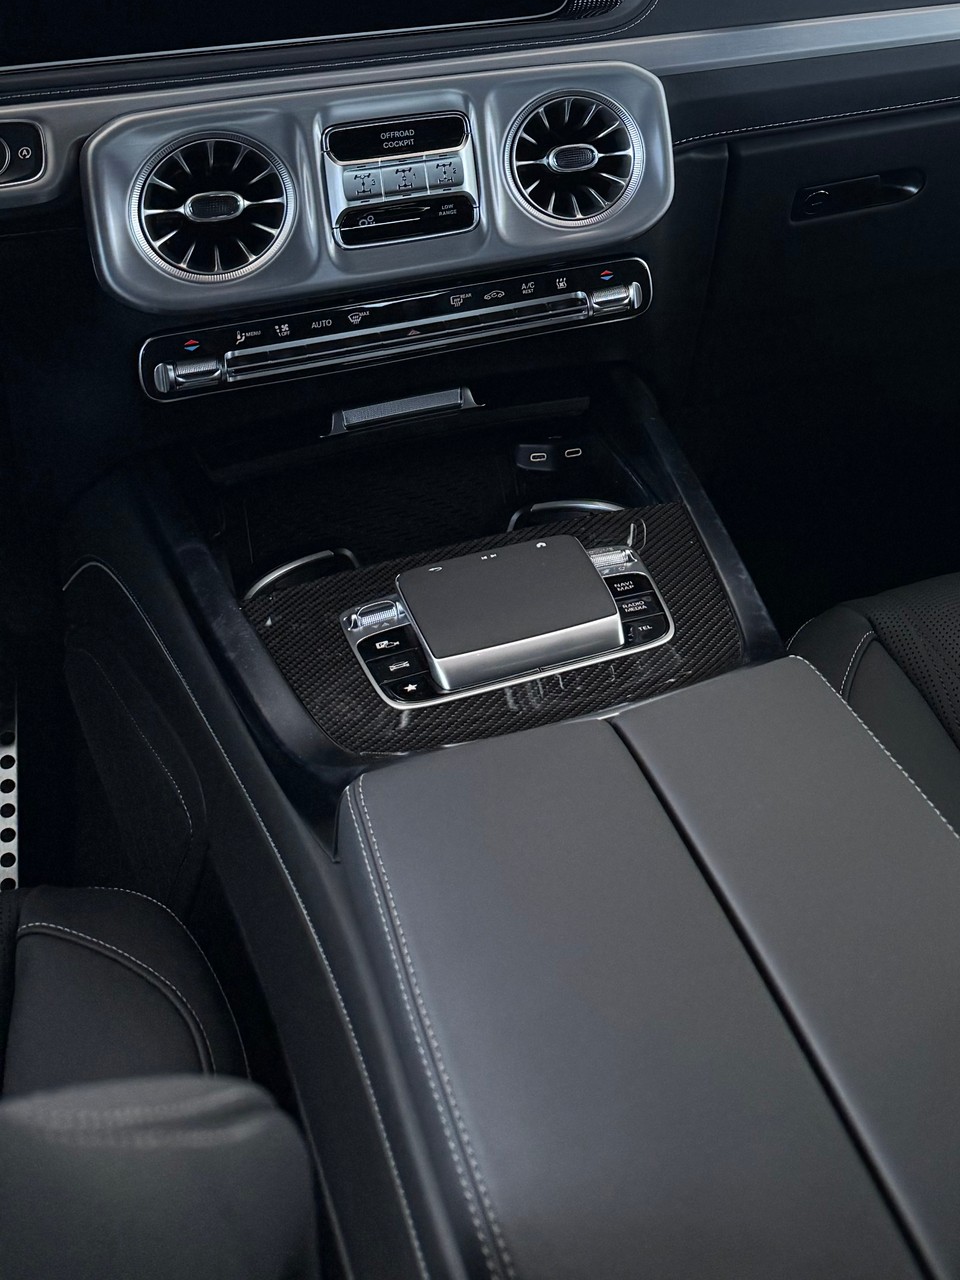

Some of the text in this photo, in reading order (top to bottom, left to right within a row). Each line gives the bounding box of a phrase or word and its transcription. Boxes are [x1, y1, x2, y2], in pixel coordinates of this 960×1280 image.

[380, 130, 415, 139] OFFROAD
[383, 139, 415, 148] COCKPIT
[521, 281, 535, 290] A/C
[311, 319, 332, 329] AUTO
[622, 600, 645, 609] RADIO
